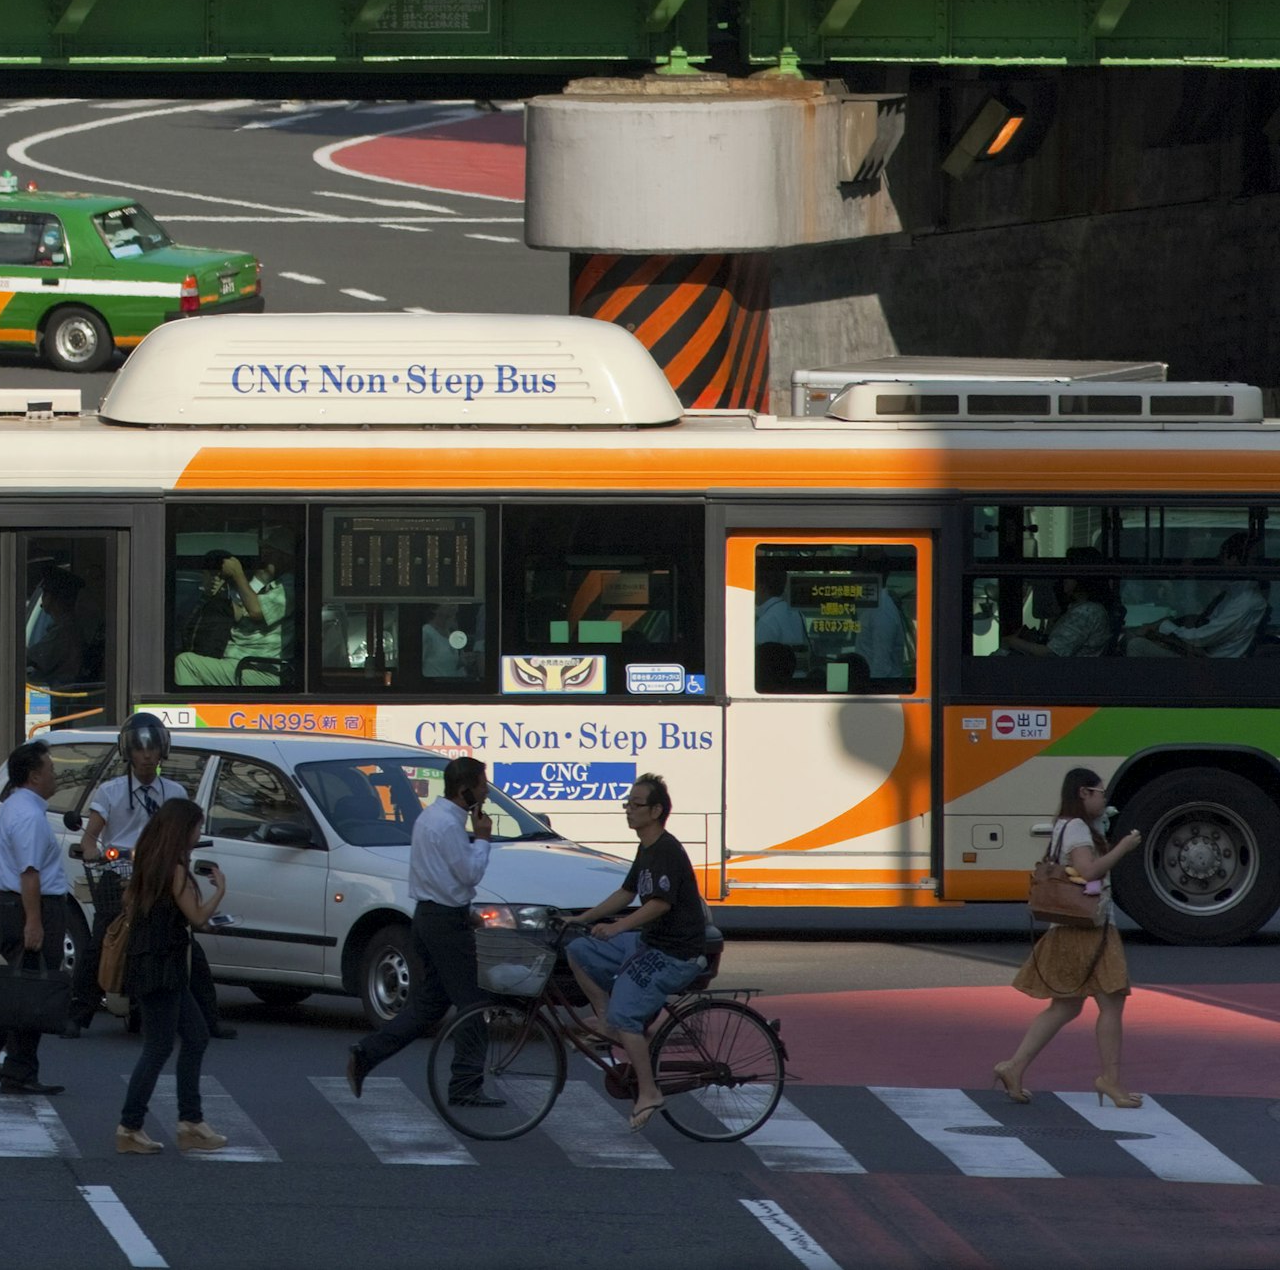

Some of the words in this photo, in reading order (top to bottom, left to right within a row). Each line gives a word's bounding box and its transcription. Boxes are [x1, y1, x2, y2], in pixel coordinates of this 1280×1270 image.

[231, 364, 311, 394] CNG
[494, 364, 558, 395] Bus
[161, 711, 190, 725] 入口
[1017, 712, 1048, 727] 出口
[415, 721, 488, 749] CNG
[657, 722, 714, 750] Bus
[1021, 729, 1044, 738] EXIT
[540, 762, 589, 782] CNG
